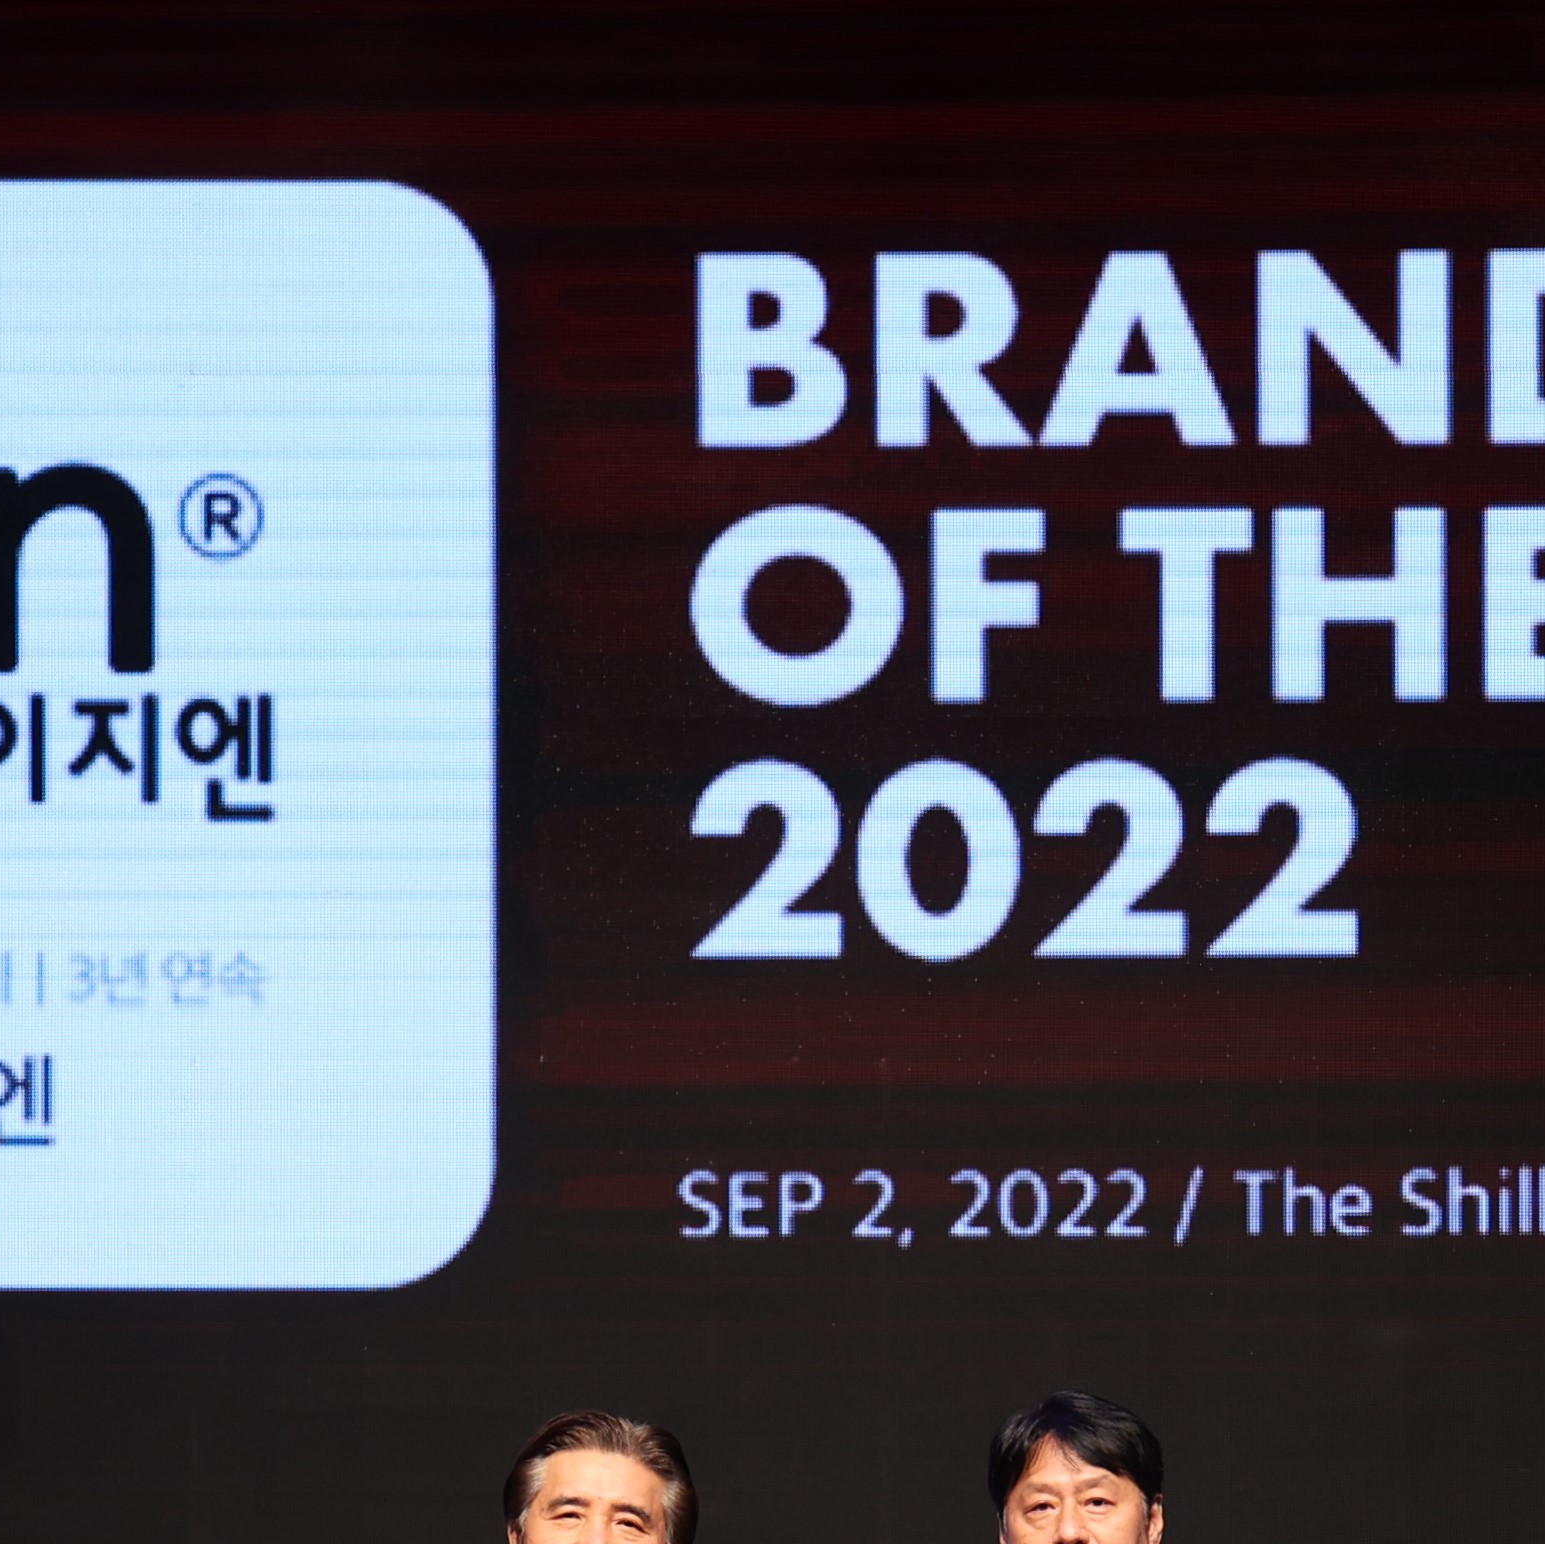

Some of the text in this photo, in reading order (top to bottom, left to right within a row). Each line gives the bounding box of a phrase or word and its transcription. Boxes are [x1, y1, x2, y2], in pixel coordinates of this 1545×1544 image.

[690, 504, 1044, 706] OF
[691, 758, 1358, 961] 2022
[68, 951, 151, 1007] 3년
[160, 951, 267, 1007] 연속
[678, 1169, 823, 1238] SEP
[852, 1169, 913, 1248] 2,
[949, 1168, 1147, 1238] 2022
[1234, 1167, 1372, 1236] The
